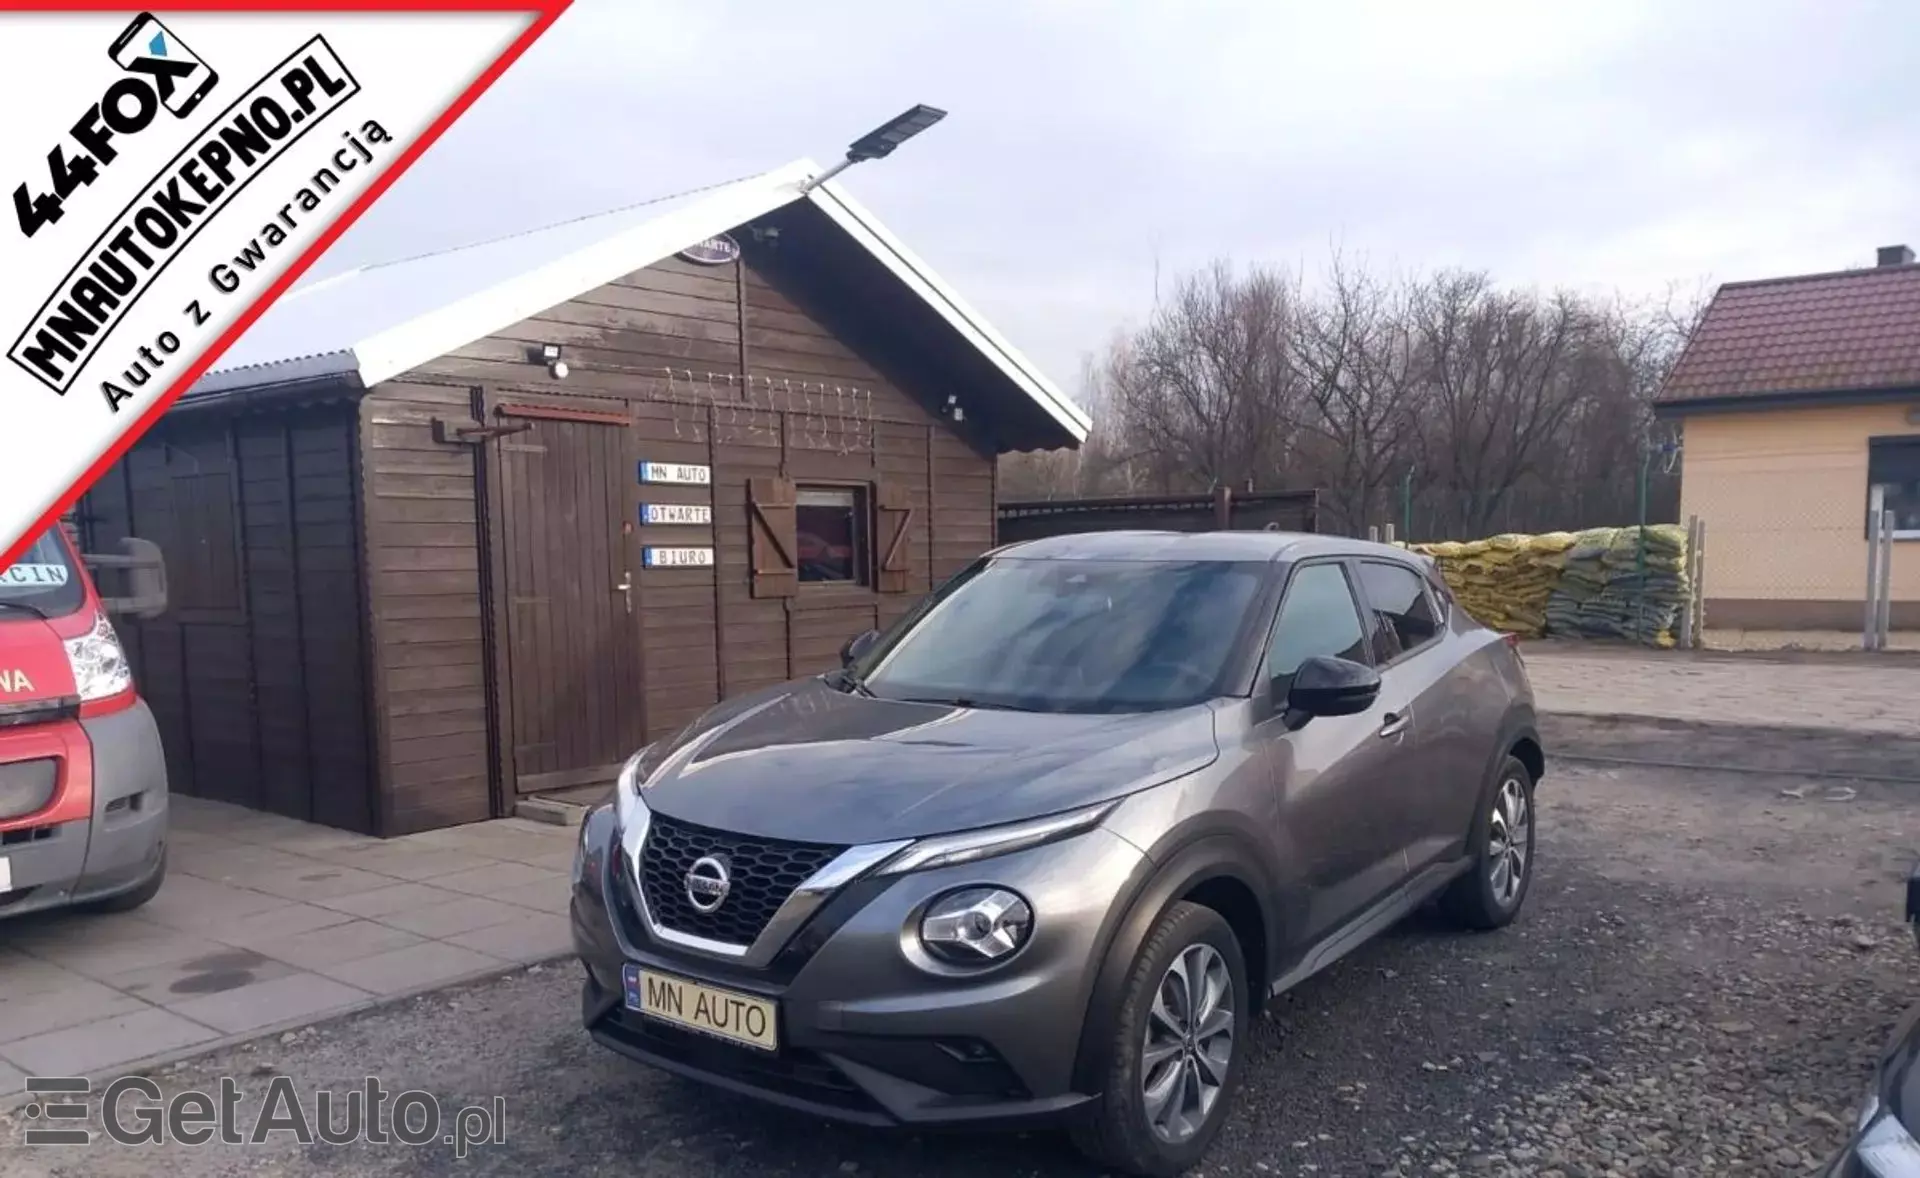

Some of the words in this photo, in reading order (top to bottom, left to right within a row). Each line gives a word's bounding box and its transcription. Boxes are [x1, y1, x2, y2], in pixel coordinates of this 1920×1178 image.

[651, 465, 667, 480] MN
[677, 466, 706, 481] AUTO
[651, 507, 709, 523] OTWARTE
[659, 550, 706, 565] BIURO
[648, 977, 683, 1016] MN
[693, 990, 766, 1037] AUTO
